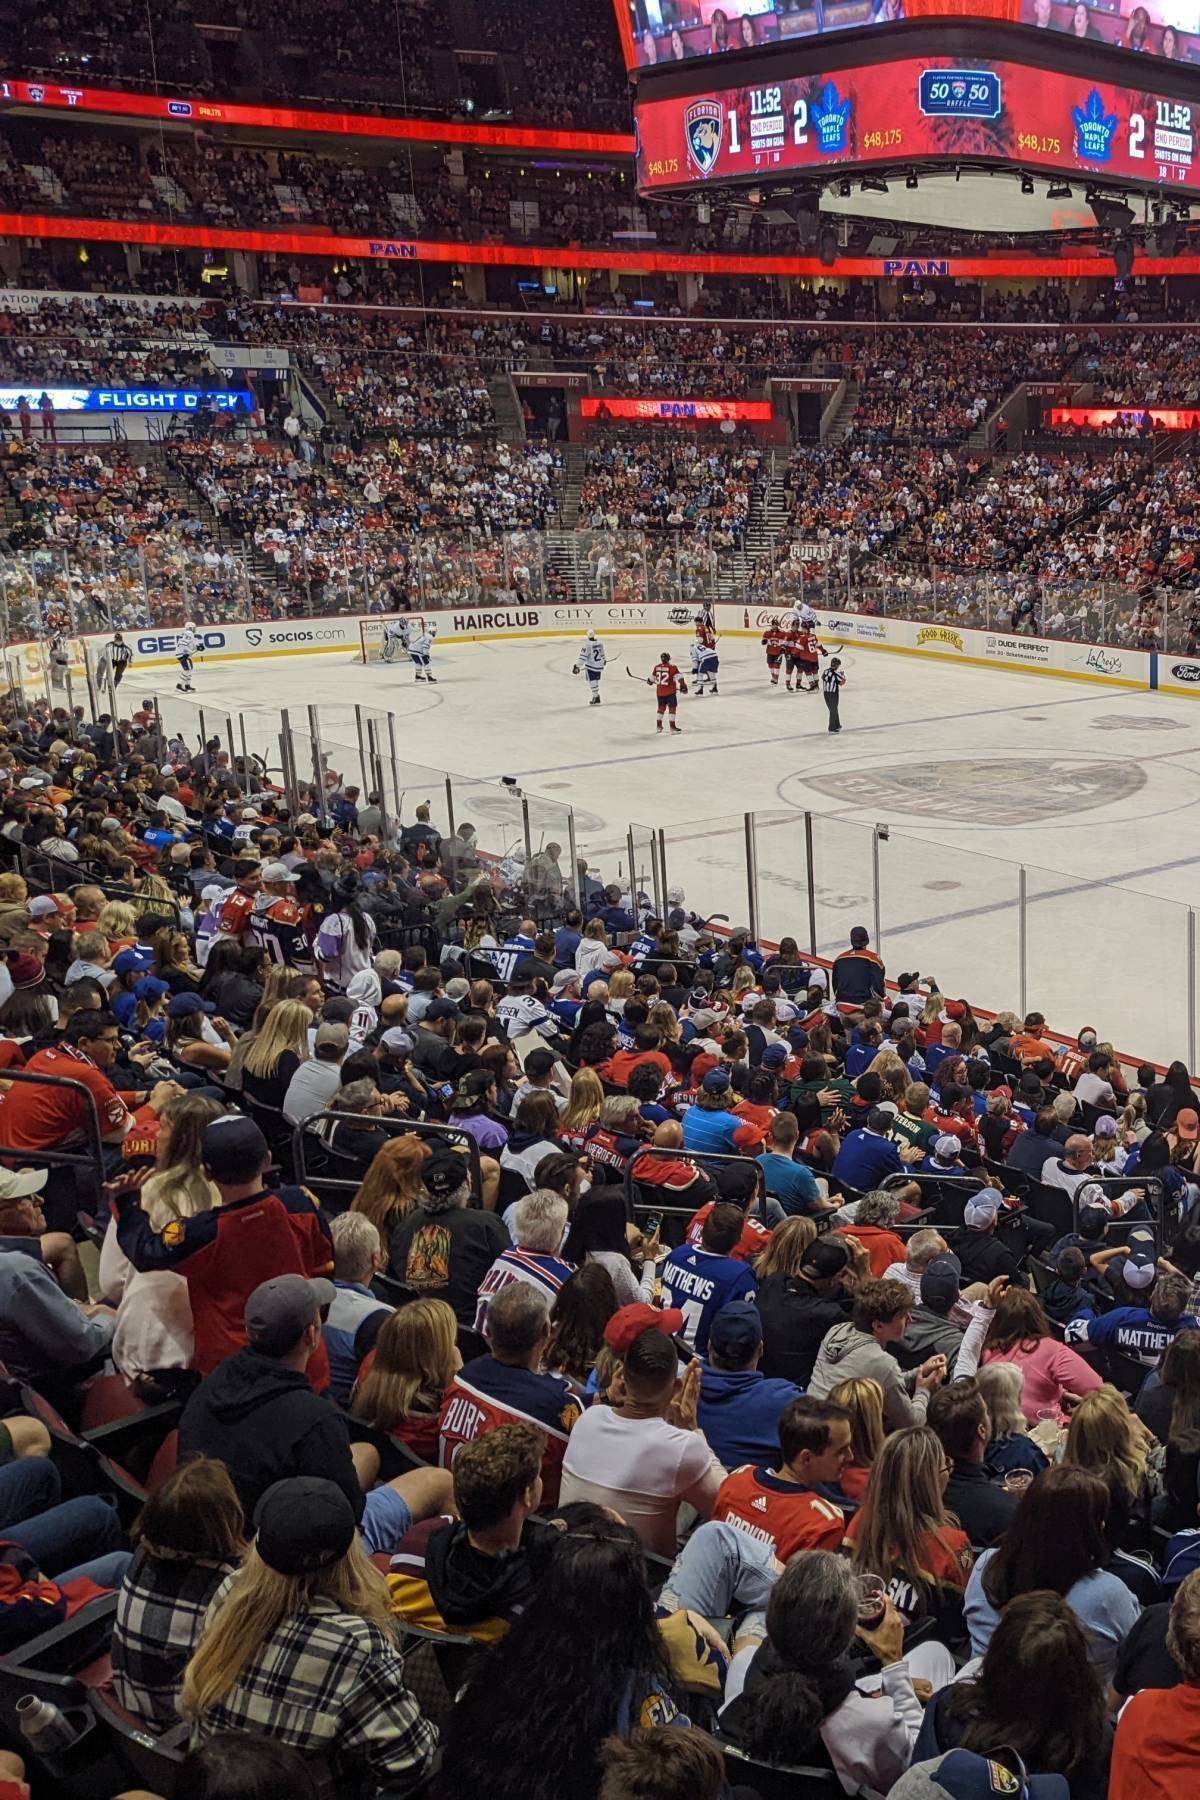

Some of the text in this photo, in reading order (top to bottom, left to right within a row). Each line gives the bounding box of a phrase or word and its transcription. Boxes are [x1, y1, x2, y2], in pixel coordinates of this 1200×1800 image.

[930, 84, 989, 101] 50 50
[750, 87, 782, 116] 11:52
[946, 99, 971, 108] RAFFLE
[689, 106, 718, 120] FLORIDA
[817, 113, 844, 128] TORONTO
[1156, 101, 1192, 131] 11:52
[751, 122, 762, 135] 2ND
[794, 99, 808, 145] 2
[728, 110, 741, 154] 1
[822, 125, 841, 135] MAPLE
[1079, 122, 1110, 138] TORONTO
[1084, 132, 1105, 143] MAPLE
[1129, 113, 1145, 159] 2
[822, 133, 841, 144] LEAFS
[864, 130, 902, 150] $48,175
[1018, 134, 1062, 154] $48,175
[1155, 132, 1167, 144] 2ND
[1084, 141, 1105, 152] LEAFS
[648, 159, 678, 177] $48,175
[1159, 167, 1167, 177] 18
[1179, 170, 1186, 181] 17
[370, 241, 417, 258] PAN
[883, 260, 948, 276] PAN
[99, 393, 178, 407] FLIGHT
[184, 394, 239, 408] DCK
[661, 403, 695, 417] PAN
[554, 609, 594, 620] CITY
[608, 608, 647, 619] CITY
[667, 609, 695, 620] NHL
[454, 611, 540, 632] HAIRCLUB
[921, 628, 959, 645] GOOD GREEK
[998, 638, 1050, 653] DUDE PERFECT
[231, 894, 247, 907] 13
[662, 1261, 715, 1302] MATTHEWS
[1118, 1328, 1176, 1350] MATTHEW
